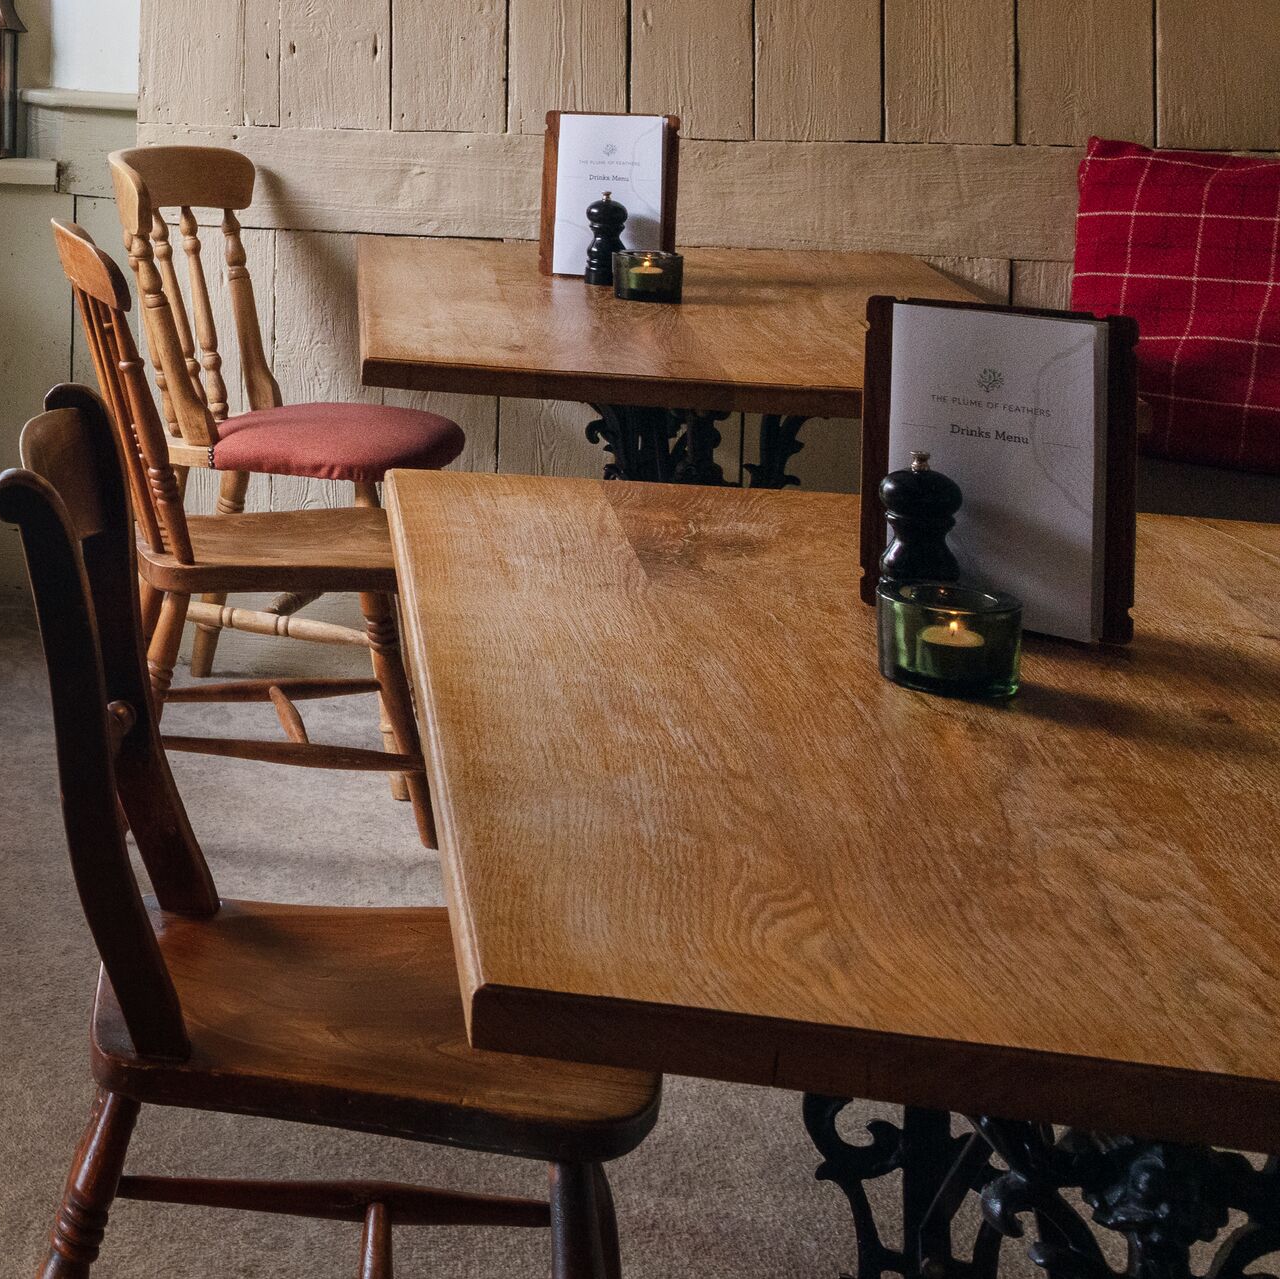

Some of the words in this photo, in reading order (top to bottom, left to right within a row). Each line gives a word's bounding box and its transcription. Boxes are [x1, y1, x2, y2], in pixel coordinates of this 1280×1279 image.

[589, 173, 610, 181] Drinks
[931, 394, 950, 403] THE
[951, 396, 984, 408] PLUME
[986, 401, 1000, 410] OF
[1002, 403, 1052, 418] FEATHERS
[950, 423, 991, 439] Drinks
[994, 429, 1030, 445] Menu
